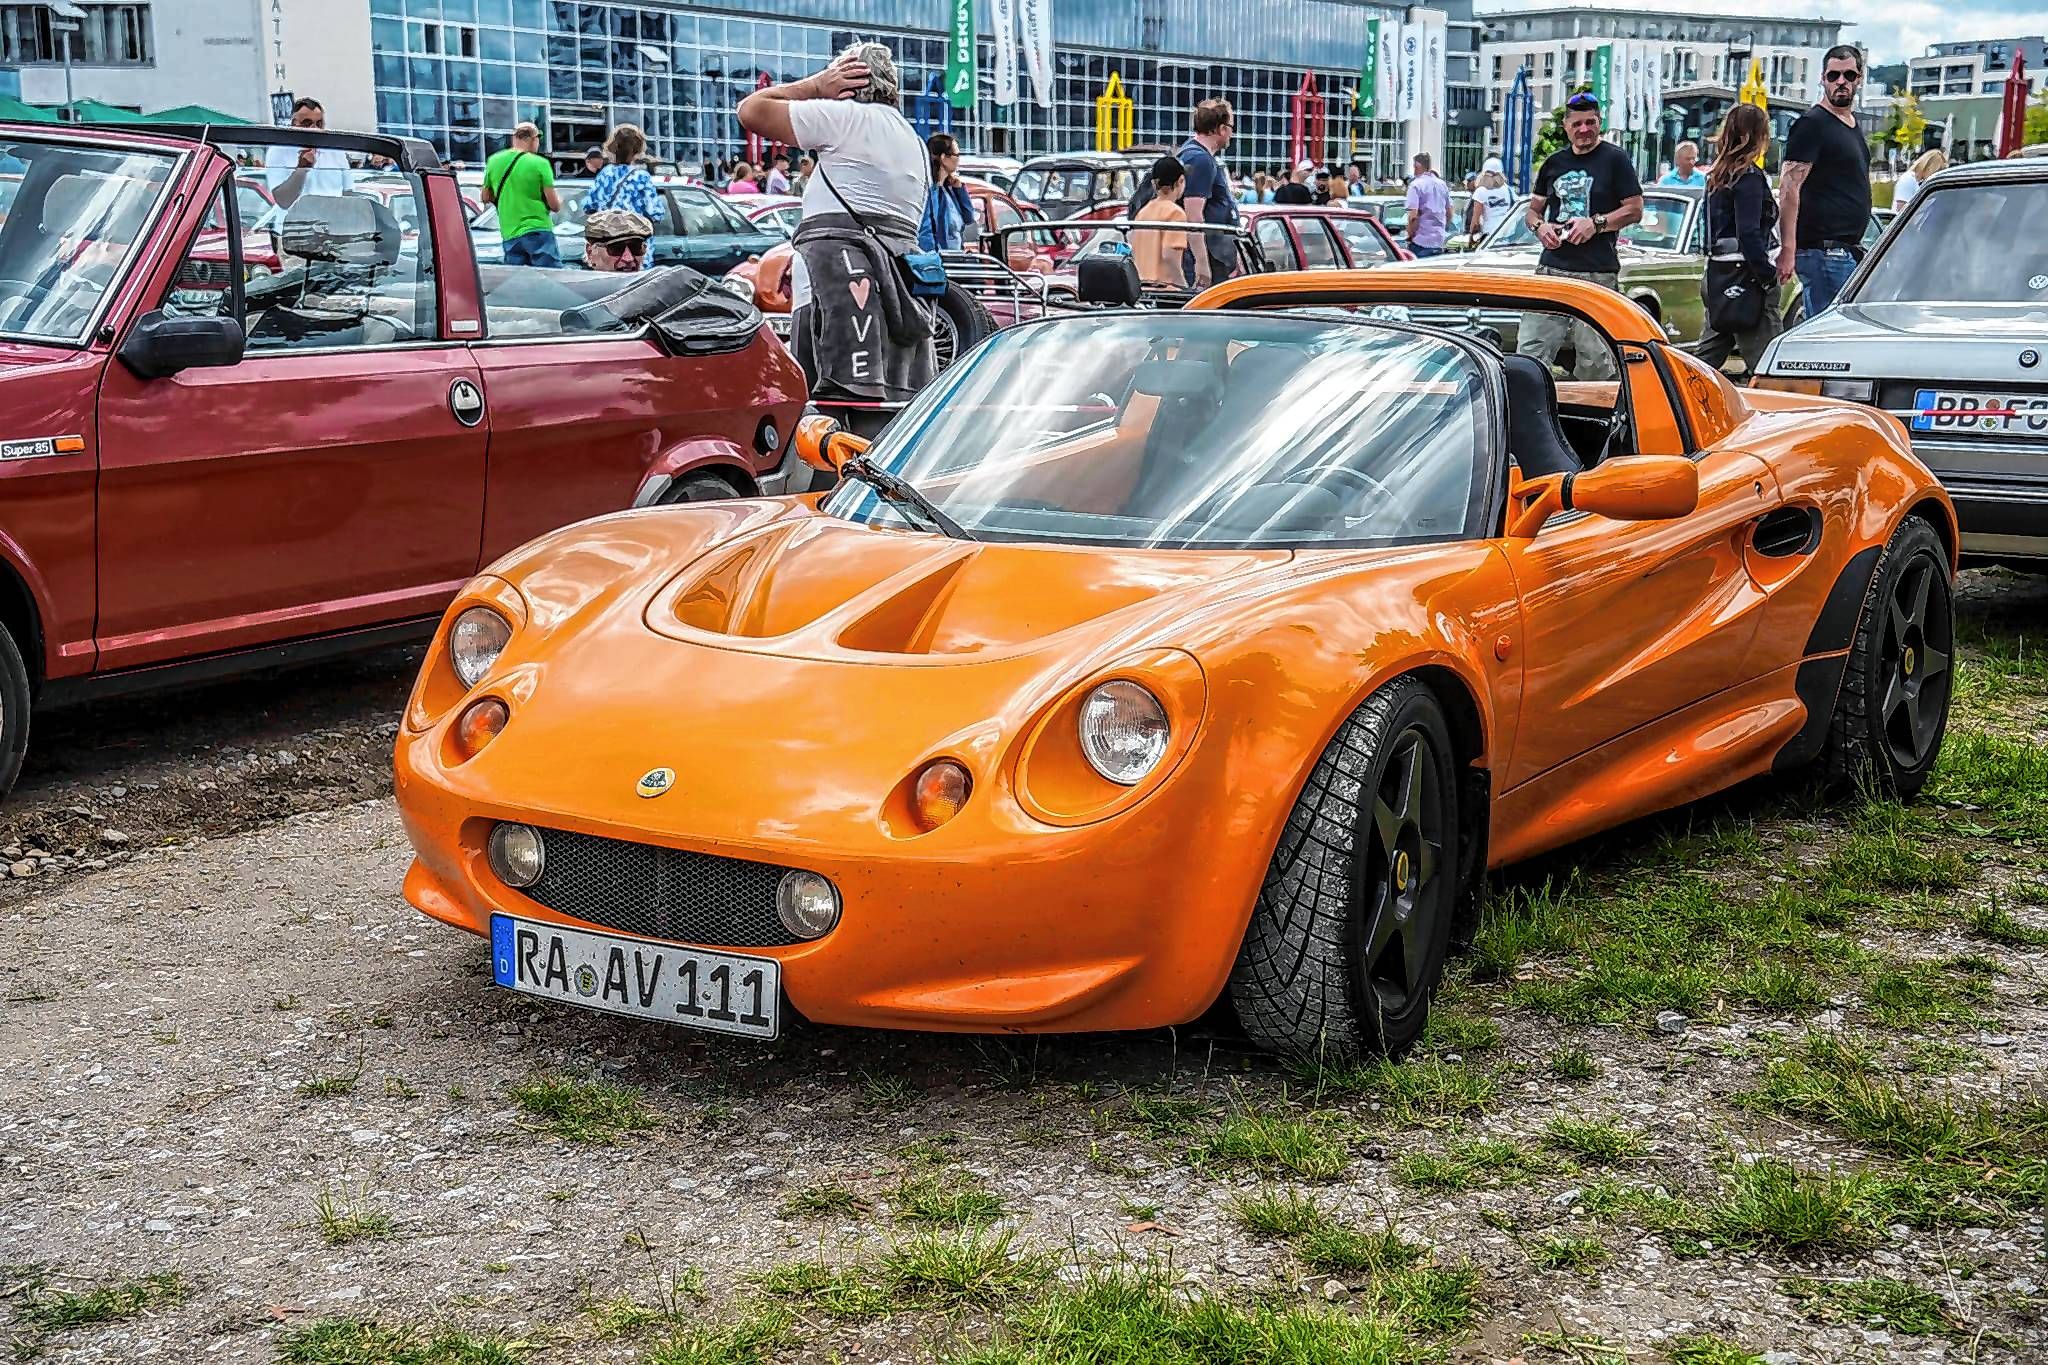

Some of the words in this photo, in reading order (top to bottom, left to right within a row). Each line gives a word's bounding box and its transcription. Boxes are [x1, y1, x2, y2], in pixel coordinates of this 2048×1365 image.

[1780, 361, 1847, 371] VOLKSWAGEN
[1935, 396, 1980, 428] BB
[3, 444, 35, 457] Super
[35, 441, 49, 454] 85
[499, 957, 509, 975] D
[517, 928, 570, 993] RA
[602, 946, 663, 1008] AV
[676, 958, 771, 1028] 111
